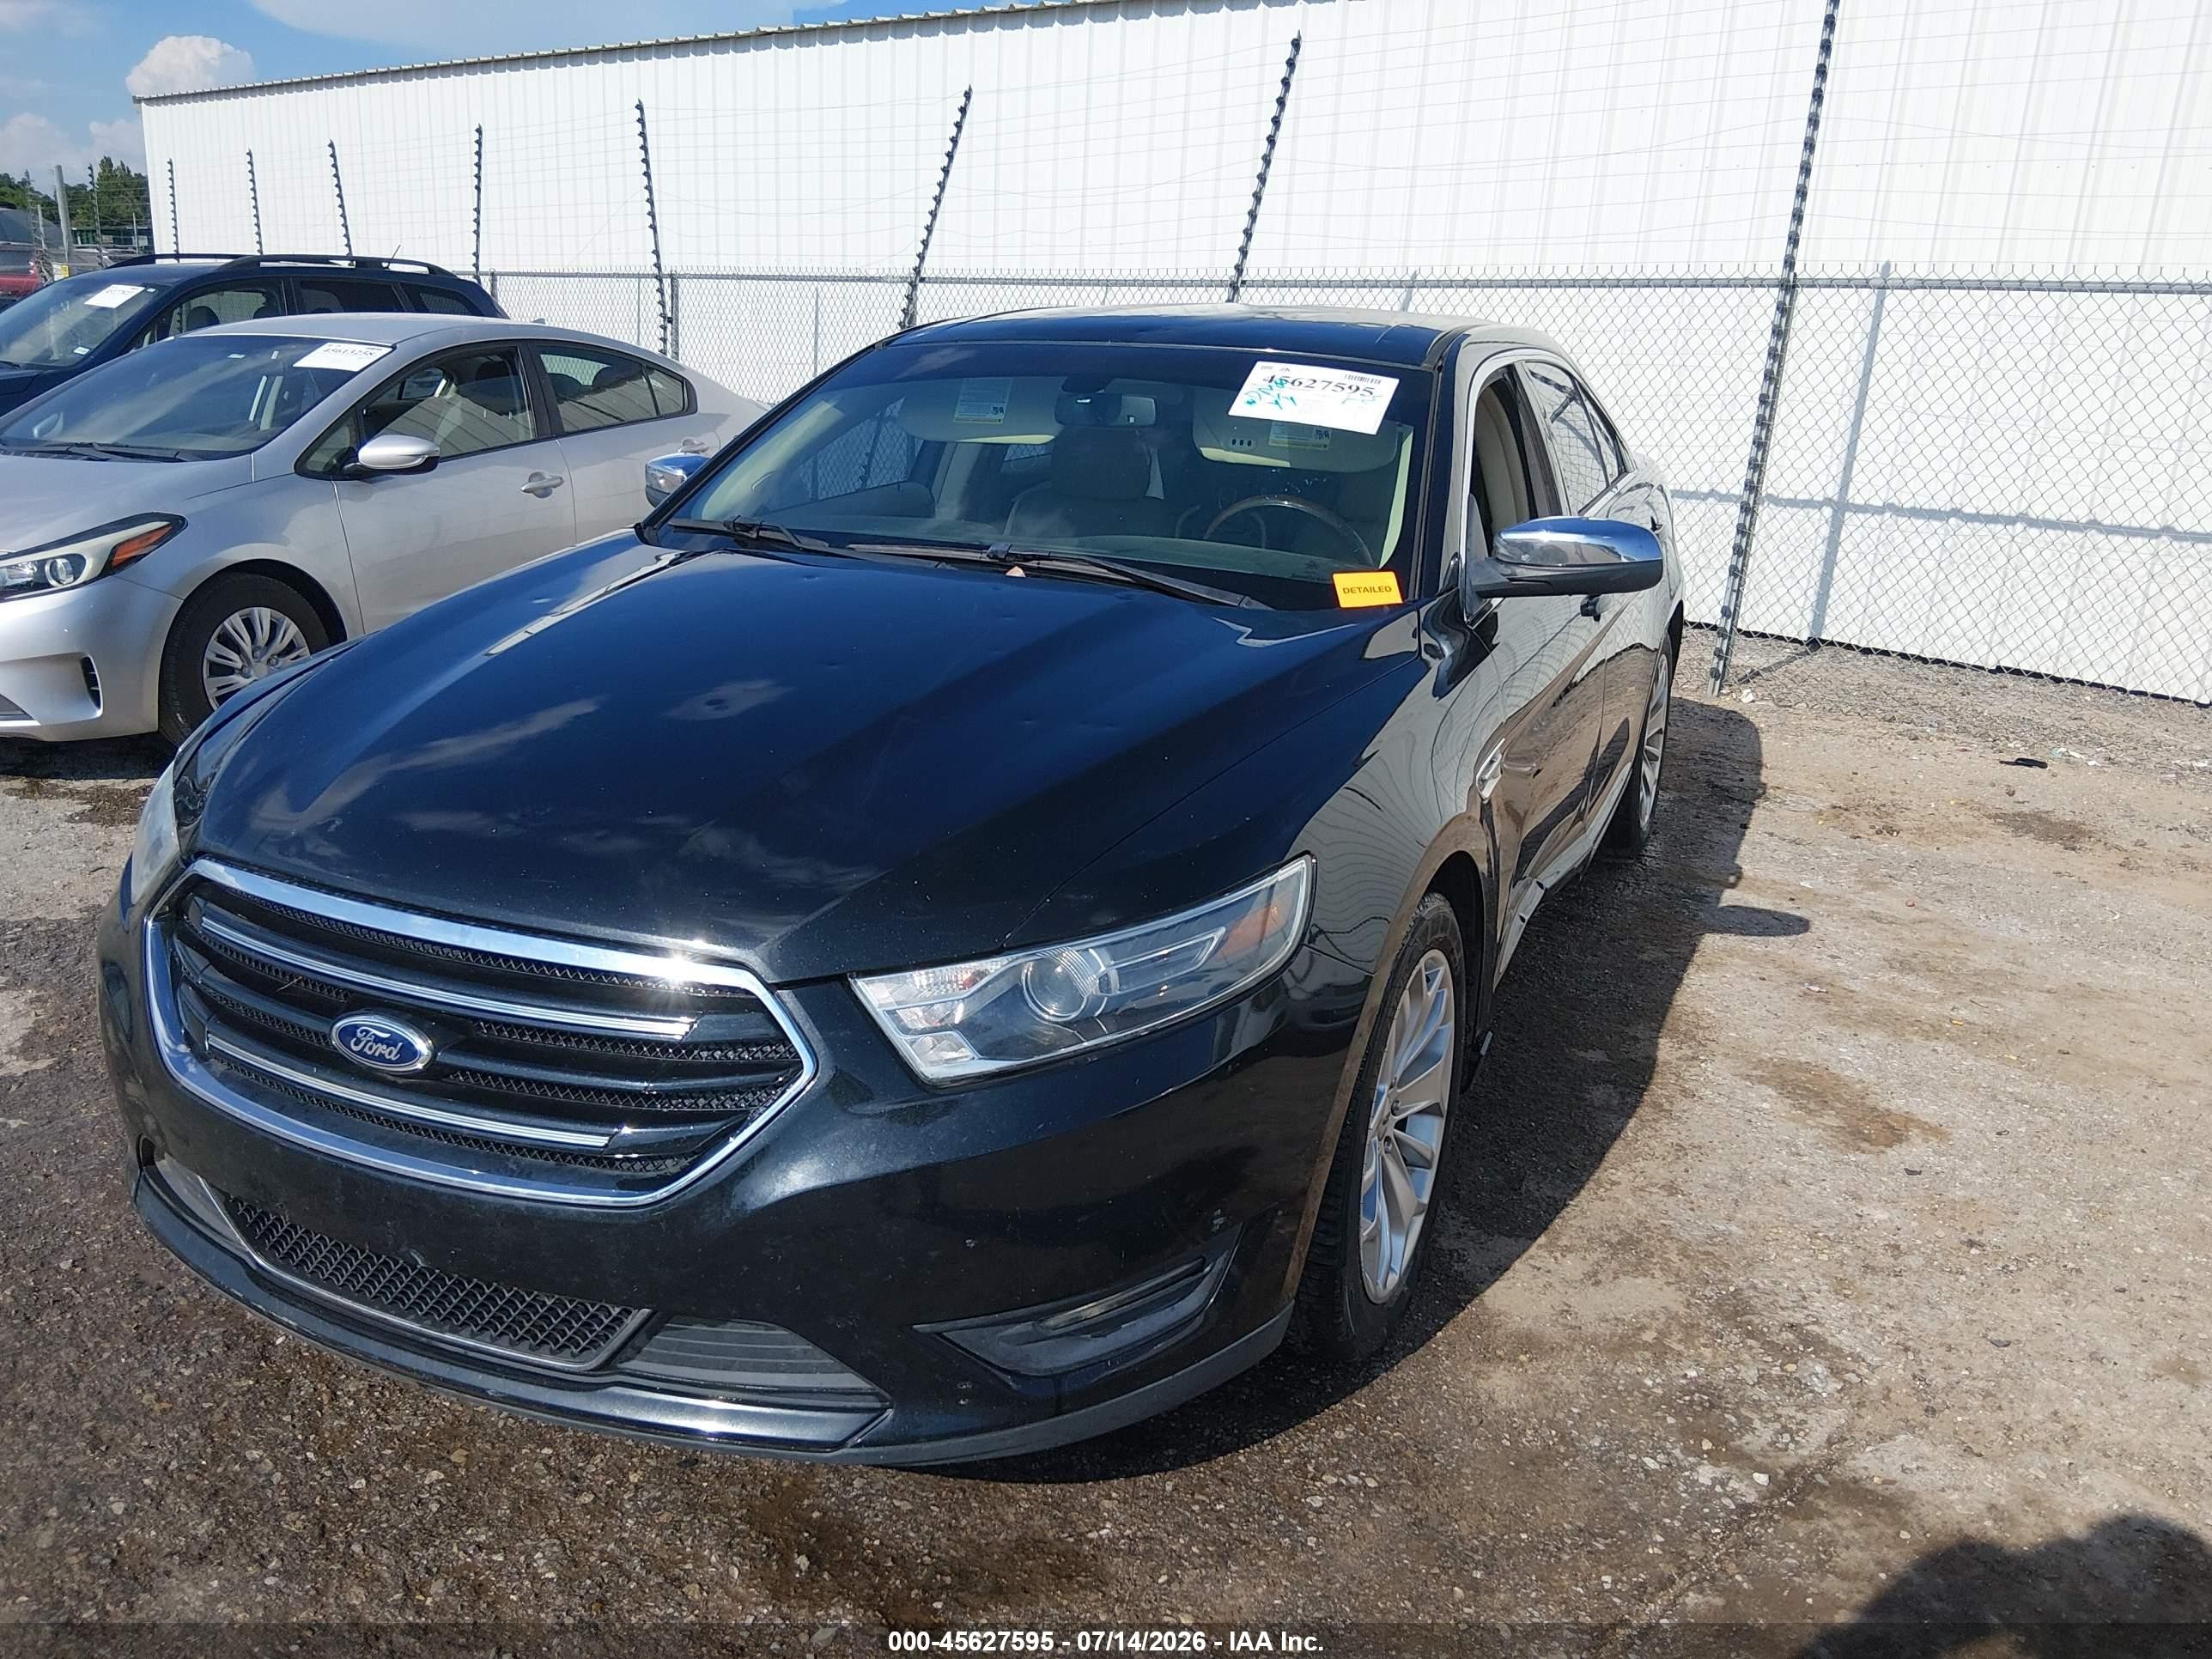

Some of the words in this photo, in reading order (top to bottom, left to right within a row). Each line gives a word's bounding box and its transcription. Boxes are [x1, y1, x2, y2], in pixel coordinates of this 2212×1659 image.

[1262, 374, 1375, 397] 45627595
[1342, 585, 1392, 594] DETAILED
[349, 1025, 404, 1061] Ford
